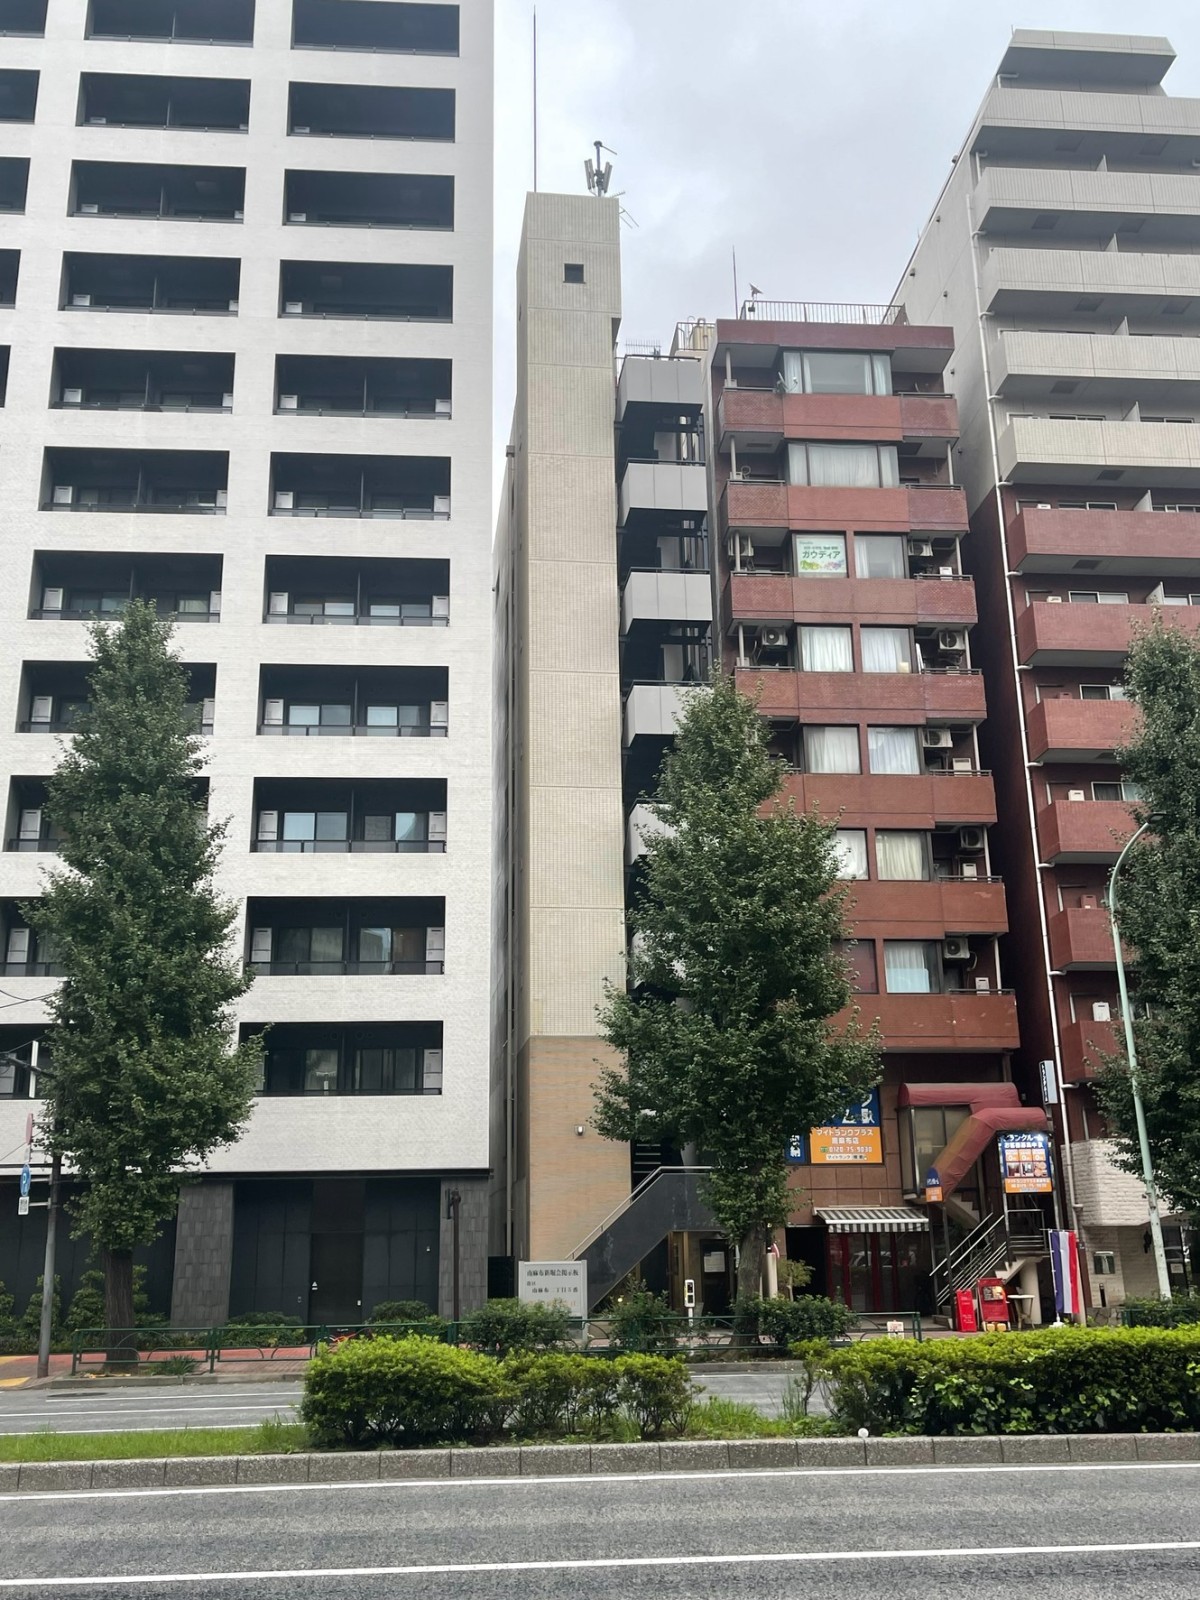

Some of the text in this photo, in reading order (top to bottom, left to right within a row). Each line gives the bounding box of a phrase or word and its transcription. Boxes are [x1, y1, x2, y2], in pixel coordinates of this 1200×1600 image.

[802, 550, 840, 559] ガウディア
